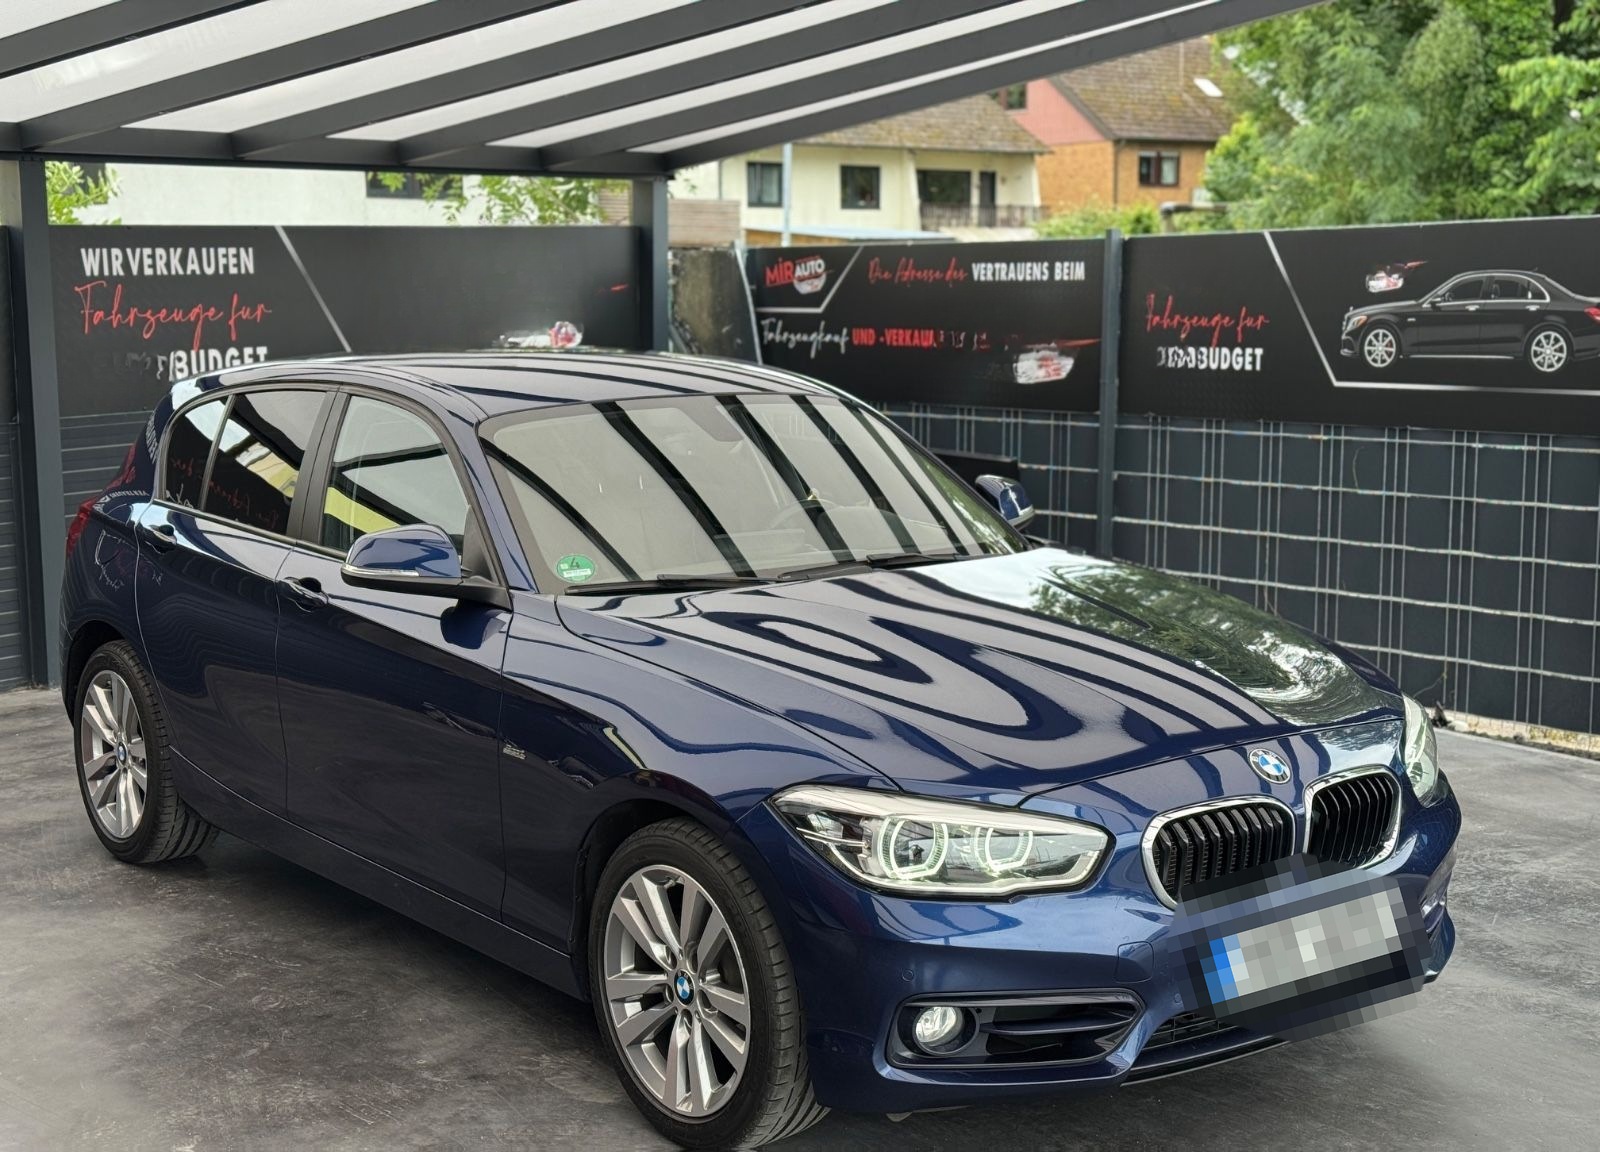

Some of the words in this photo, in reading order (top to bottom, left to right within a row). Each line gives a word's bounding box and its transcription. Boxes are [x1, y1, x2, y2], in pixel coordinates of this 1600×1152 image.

[126, 246, 255, 276] VERKAUFEN
[794, 259, 825, 277] AUTO
[971, 261, 1049, 281] VERTRAUENS
[1054, 260, 1086, 281] BEIM
[74, 280, 224, 353] Fahrzeuge
[851, 327, 875, 346] UND
[1197, 346, 1264, 371] BUDGET
